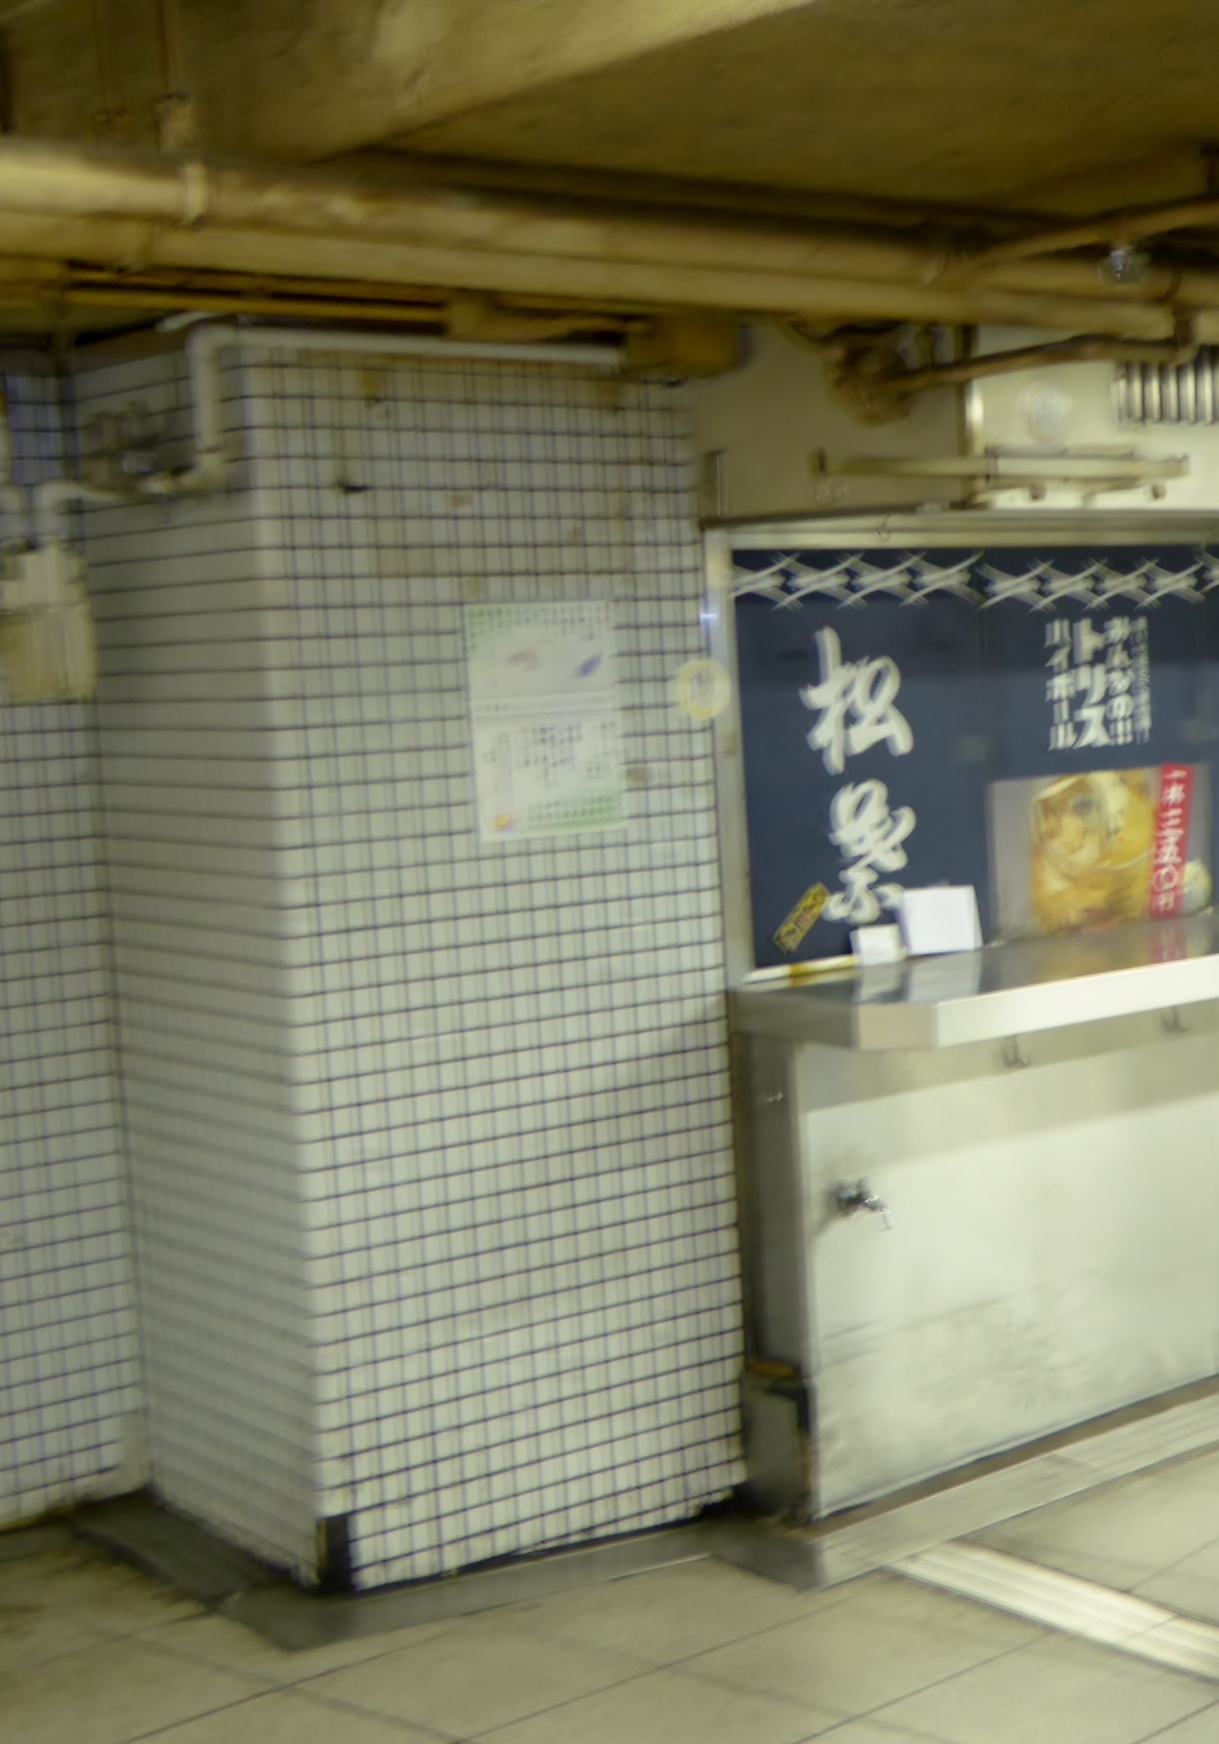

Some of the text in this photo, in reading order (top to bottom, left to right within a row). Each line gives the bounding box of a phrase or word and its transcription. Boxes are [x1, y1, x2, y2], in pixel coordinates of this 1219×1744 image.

[1043, 618, 1077, 751] ハイボール
[1072, 617, 1110, 750] トリス
